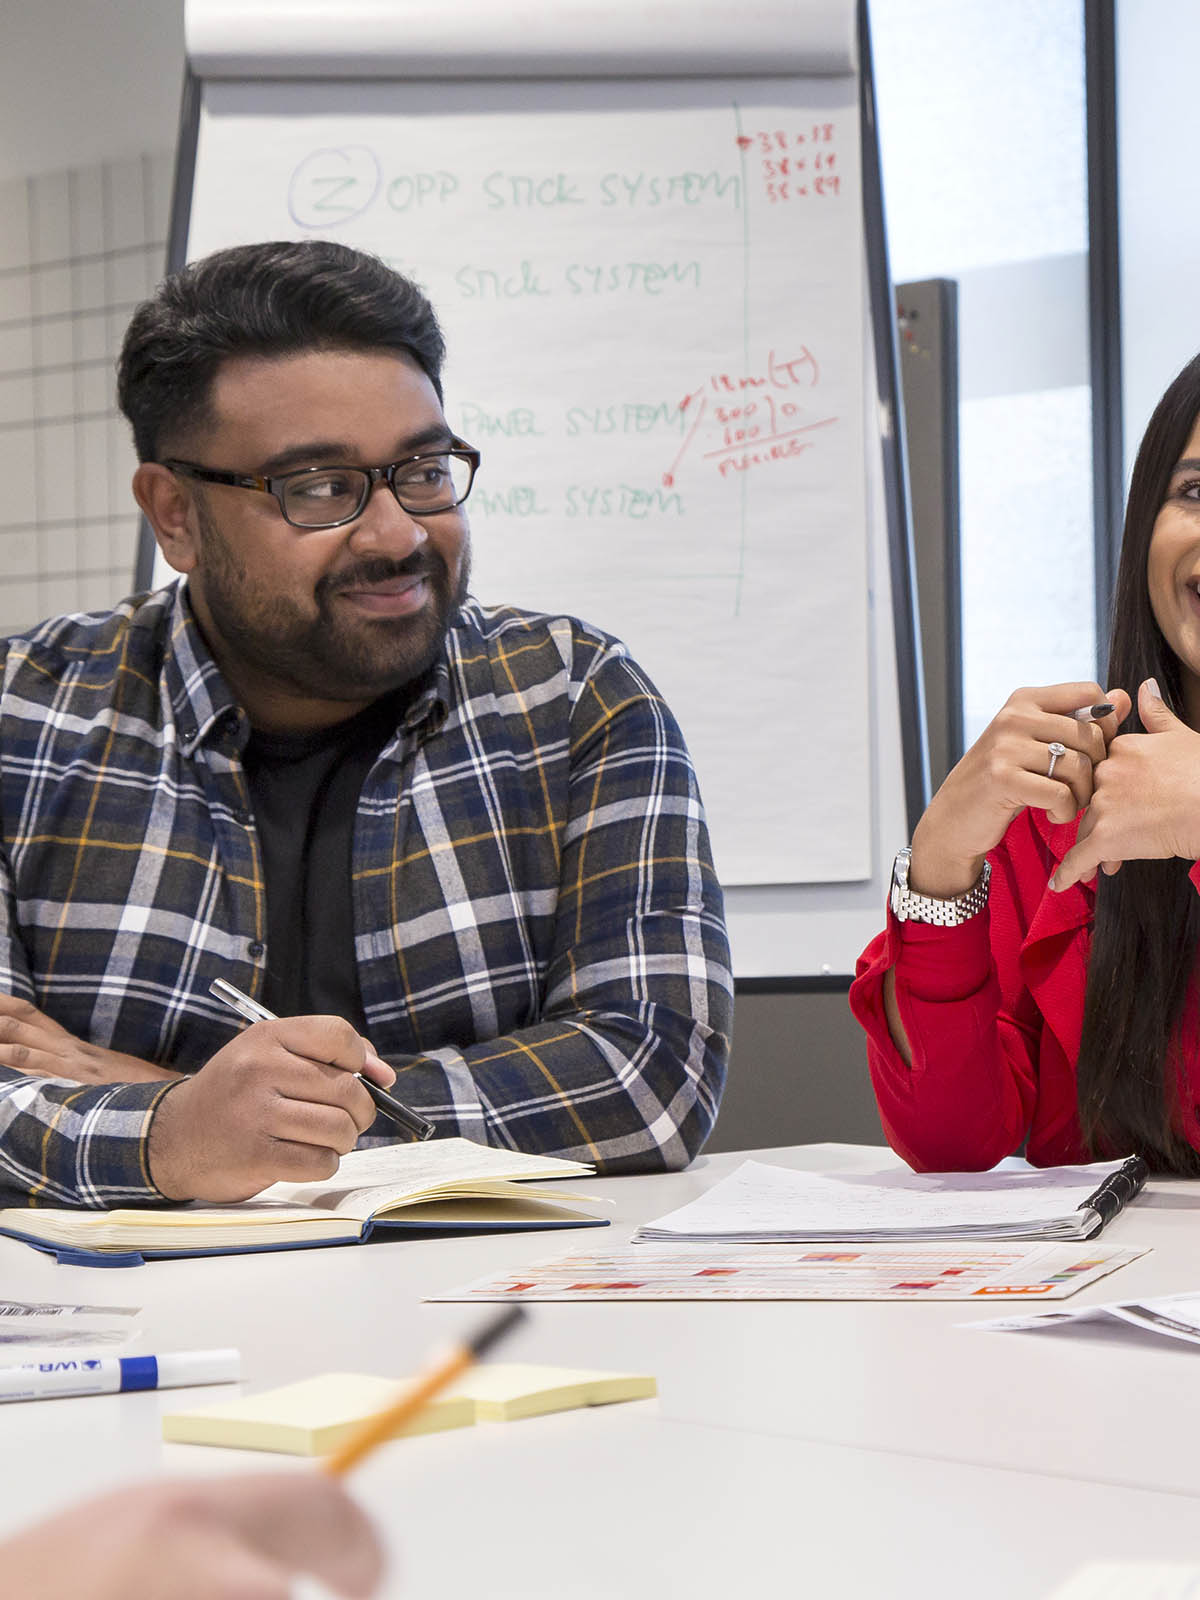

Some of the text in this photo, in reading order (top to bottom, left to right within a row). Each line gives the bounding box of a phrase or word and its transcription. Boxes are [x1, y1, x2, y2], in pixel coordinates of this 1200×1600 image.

[601, 170, 742, 210] SYSTEM
[566, 259, 702, 296] SYSTEM
[566, 401, 687, 438] SYSTEM
[564, 482, 686, 519] SYSTEM
